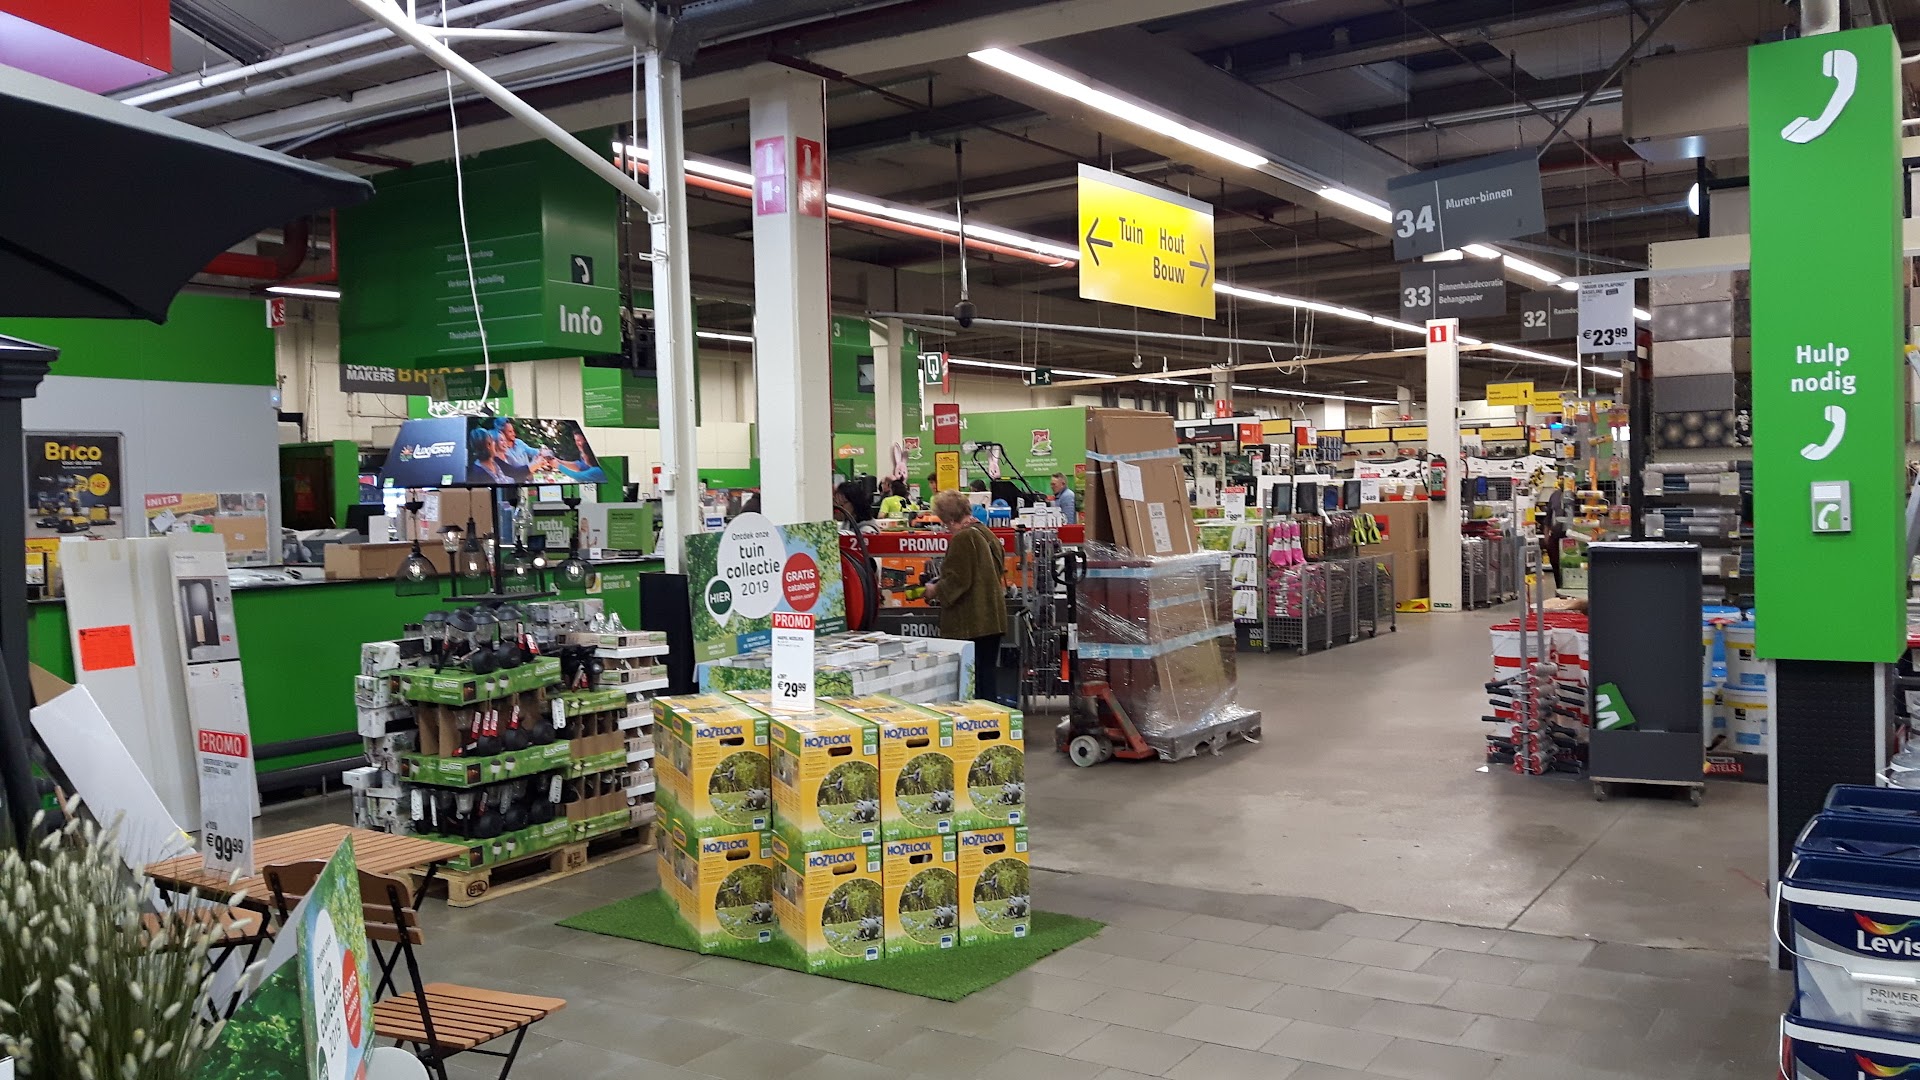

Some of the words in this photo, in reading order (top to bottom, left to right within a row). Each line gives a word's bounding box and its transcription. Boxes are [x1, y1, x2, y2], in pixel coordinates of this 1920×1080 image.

[1396, 205, 1436, 238] 34
[1445, 188, 1513, 210] Muren-binnen
[1119, 217, 1143, 245] Tuin
[1160, 227, 1185, 255] Hout
[1153, 256, 1185, 284] Bouw
[1403, 286, 1431, 307] 33
[1438, 278, 1504, 291] Binnenhuisdecoratie
[1438, 293, 1484, 304] Behangpapier
[560, 304, 603, 335] Info
[1523, 310, 1547, 328] 32
[834, 323, 841, 337] 3
[907, 332, 914, 345] 4
[1796, 342, 1850, 367] Hulp
[346, 370, 396, 383] MAKERS
[1790, 370, 1857, 395] nodig
[1523, 389, 1528, 398] 1
[44, 441, 102, 461] Brico
[536, 518, 563, 531] natu
[546, 526, 570, 541] wall
[731, 532, 753, 541] Ontdek
[755, 531, 770, 539] onze
[739, 544, 765, 559] tuin
[899, 538, 948, 551] PROMO
[726, 559, 780, 579] collectie
[785, 569, 815, 583] GRATIS
[741, 580, 769, 596] 2019
[787, 582, 816, 593] catalogus
[709, 592, 731, 604] HIER
[775, 613, 810, 628] PROMO
[900, 623, 941, 638] PROM
[696, 725, 743, 738] HOZELOCK
[884, 726, 928, 739] HOZELOCK
[956, 719, 999, 731] HOZELOCK
[201, 732, 242, 756] PROMO
[804, 734, 851, 748] HOZELOCK
[703, 839, 749, 853] HOZELOCK
[962, 832, 1004, 846] HOZELOCK
[887, 842, 932, 856] HOZELOCK
[809, 852, 855, 867] HOZELOCK
[1857, 929, 1920, 958] Levis
[1870, 988, 1919, 1003] PRIMER
